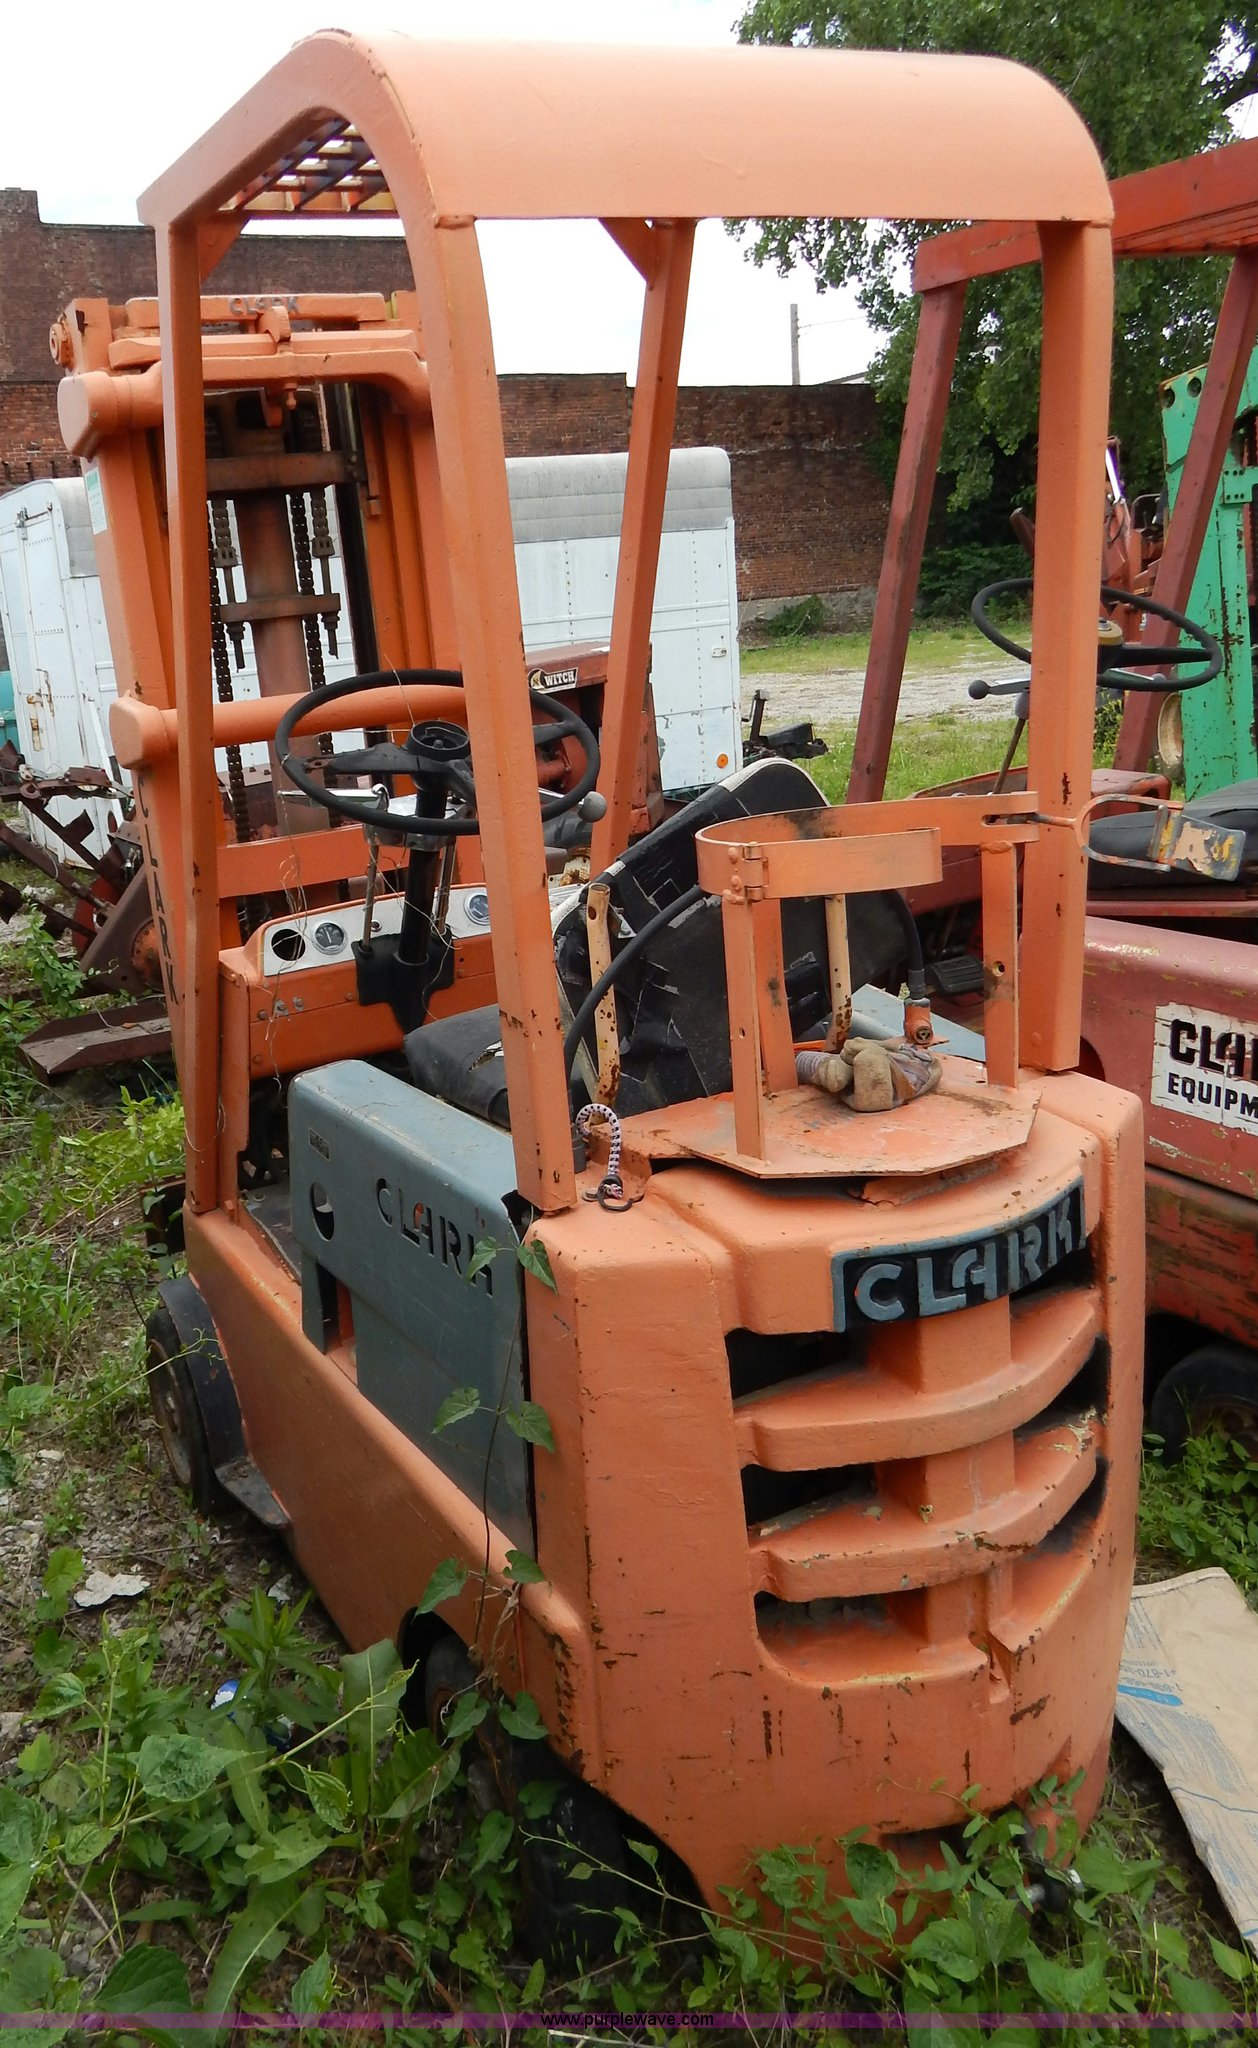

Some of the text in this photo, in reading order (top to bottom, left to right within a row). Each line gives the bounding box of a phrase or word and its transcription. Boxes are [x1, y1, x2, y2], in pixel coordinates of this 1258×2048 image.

[544, 671, 575, 687] WITCH
[138, 774, 179, 1006] CLARK
[1169, 1018, 1258, 1083] CLA
[372, 1178, 493, 1298] CLARK
[855, 1197, 1073, 1321] CLARK
